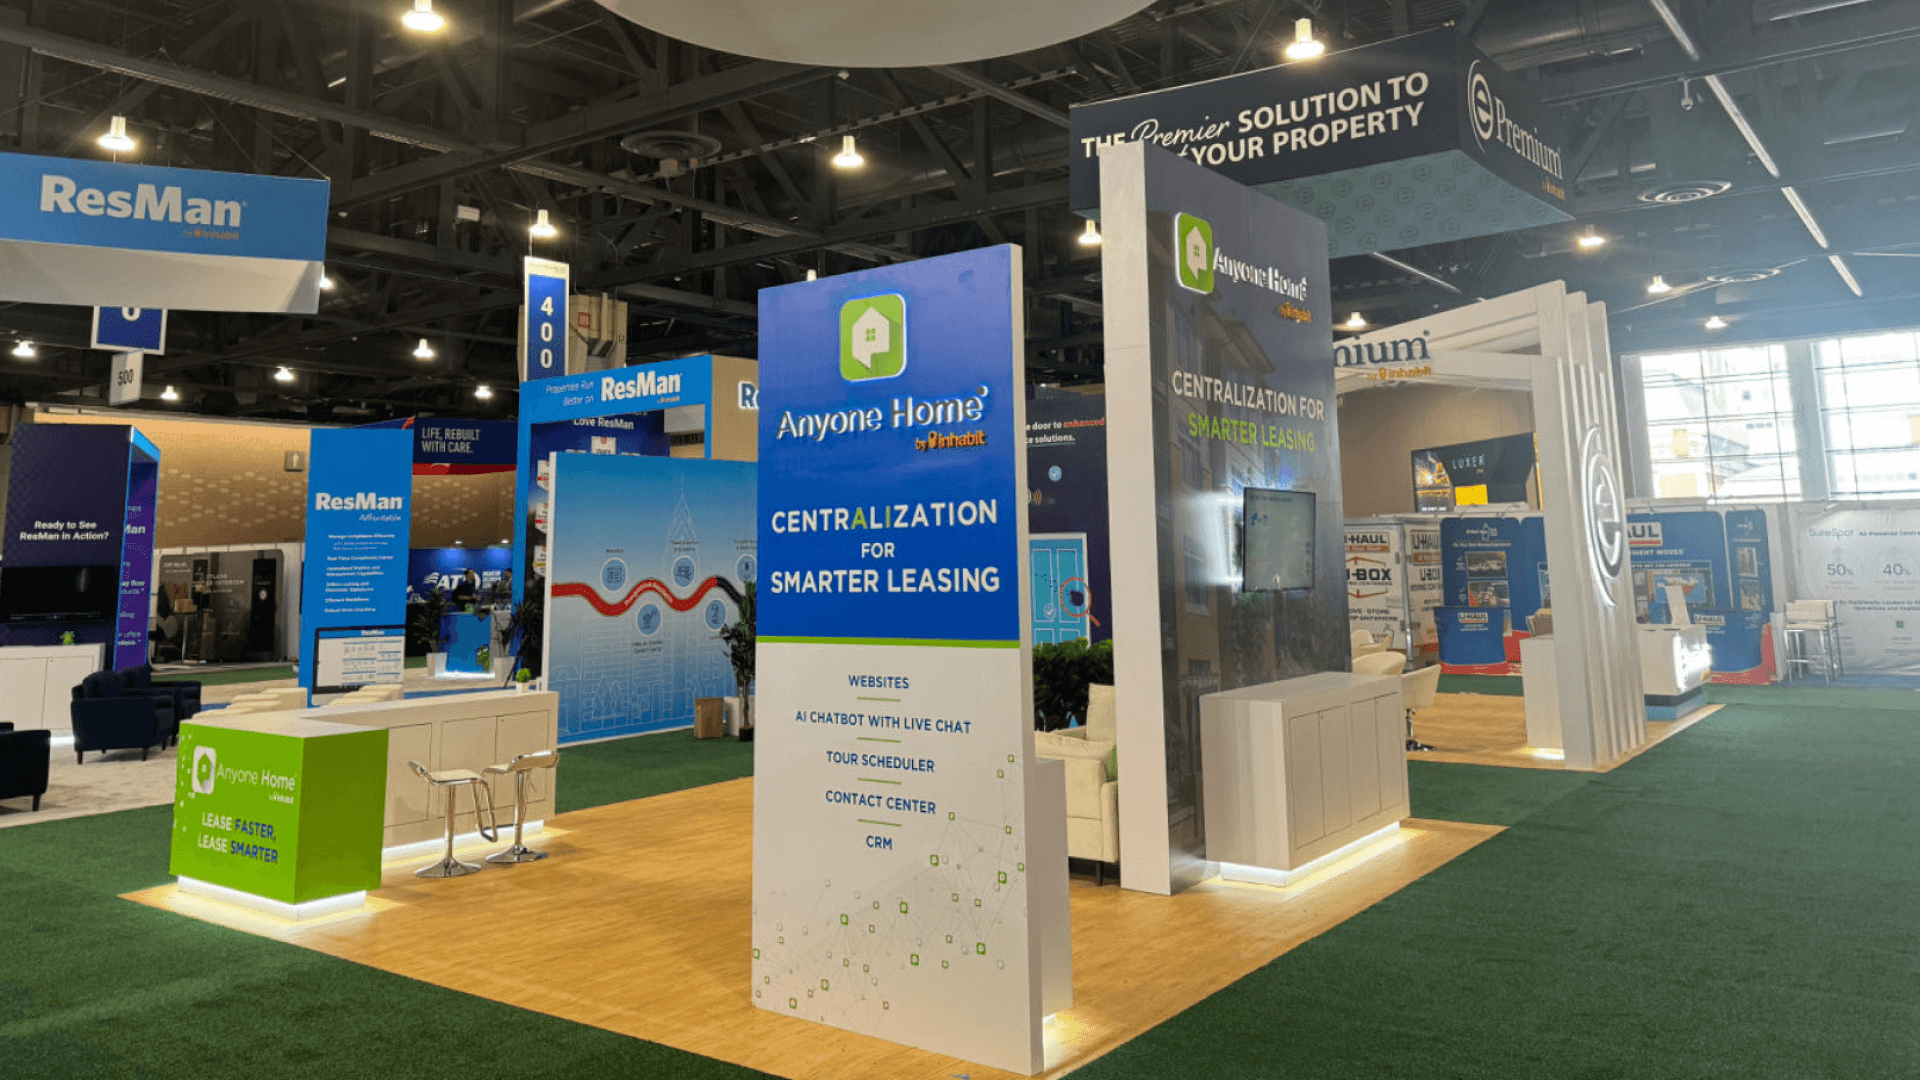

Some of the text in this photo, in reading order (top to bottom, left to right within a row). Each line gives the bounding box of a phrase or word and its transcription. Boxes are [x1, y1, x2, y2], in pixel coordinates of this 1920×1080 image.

[1081, 72, 1429, 158] THE Premier SOLUTION TO
[1191, 101, 1424, 165] YOUR PROPERTY
[1494, 96, 1563, 181] Premium
[40, 174, 241, 227] ResMan
[1213, 247, 1307, 300] Anyone Home
[601, 371, 681, 402] ResMan
[738, 381, 758, 410] R
[1172, 370, 1325, 421] CENTRALIZATION FOR
[776, 396, 984, 442] Anyone Home
[1032, 421, 1051, 430] door
[1053, 421, 1062, 430] to
[1188, 412, 1315, 452] SMARTER LEASING
[422, 427, 480, 441] LIFE, REBUILT
[422, 441, 446, 453] WITH
[938, 430, 987, 448] inhabit
[315, 492, 403, 511] ResMan
[34, 520, 97, 530] Ready to See
[771, 499, 998, 534] CENTRALIZATION
[19, 531, 109, 541] ResMan in Action?
[861, 542, 895, 558] FOR
[770, 566, 1000, 593] SMARTER LEASING
[848, 674, 910, 689] WEBSITES
[795, 711, 972, 734] AI CHATBOT WITH LIVE CHAT
[826, 751, 935, 773] TOUR SCHEDULER
[217, 763, 295, 791] Anyone Home
[825, 790, 936, 814] CONTACT CENTER
[202, 811, 276, 842] LEASE FASTER,
[197, 834, 278, 864] LEASE SMARTER
[866, 835, 893, 850] CRM
